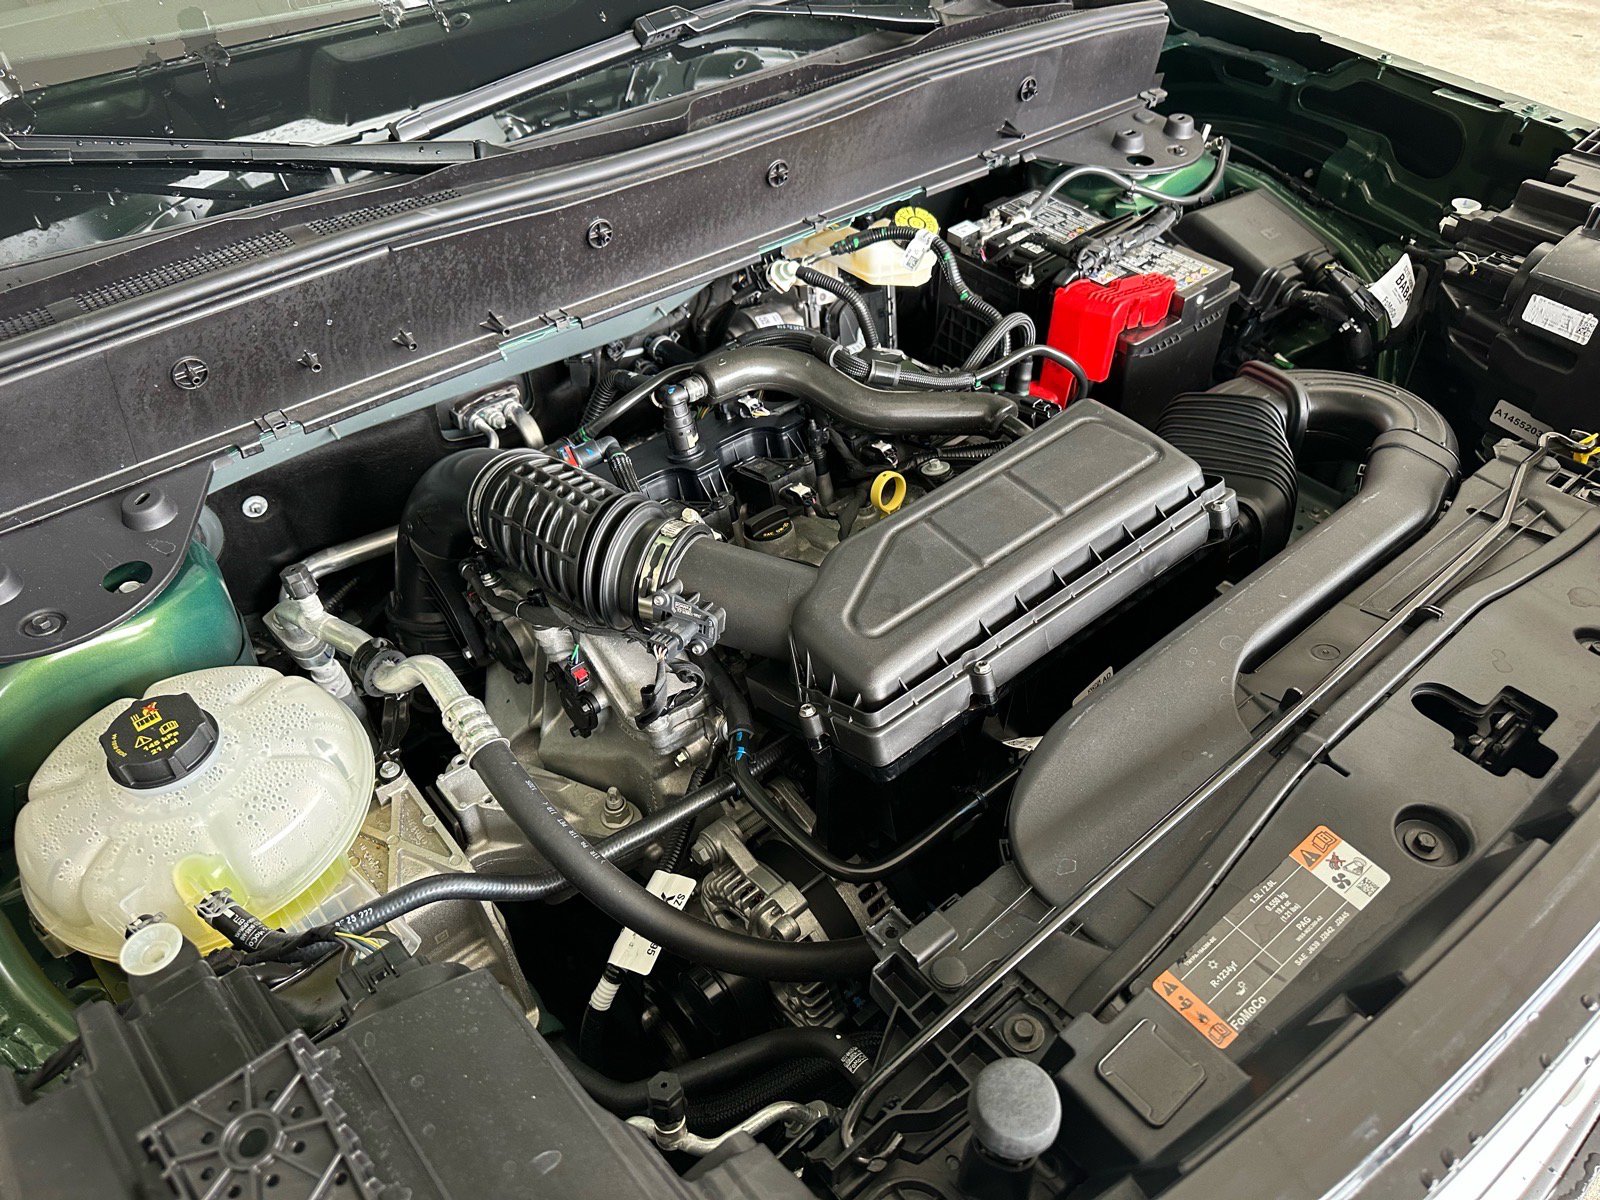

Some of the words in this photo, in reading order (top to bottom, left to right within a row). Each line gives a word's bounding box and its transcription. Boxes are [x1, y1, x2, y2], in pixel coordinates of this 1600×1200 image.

[143, 740, 160, 751] 145
[161, 731, 179, 742] kPa
[150, 747, 162, 755] 21
[164, 739, 178, 749] psi
[1250, 892, 1263, 904] 1.5L
[1263, 880, 1277, 892] 2.0L
[1296, 916, 1311, 931] PAG
[1294, 952, 1308, 966] SAE
[1210, 960, 1238, 988] R-1234yf
[1230, 996, 1267, 1031] FoMoCo
